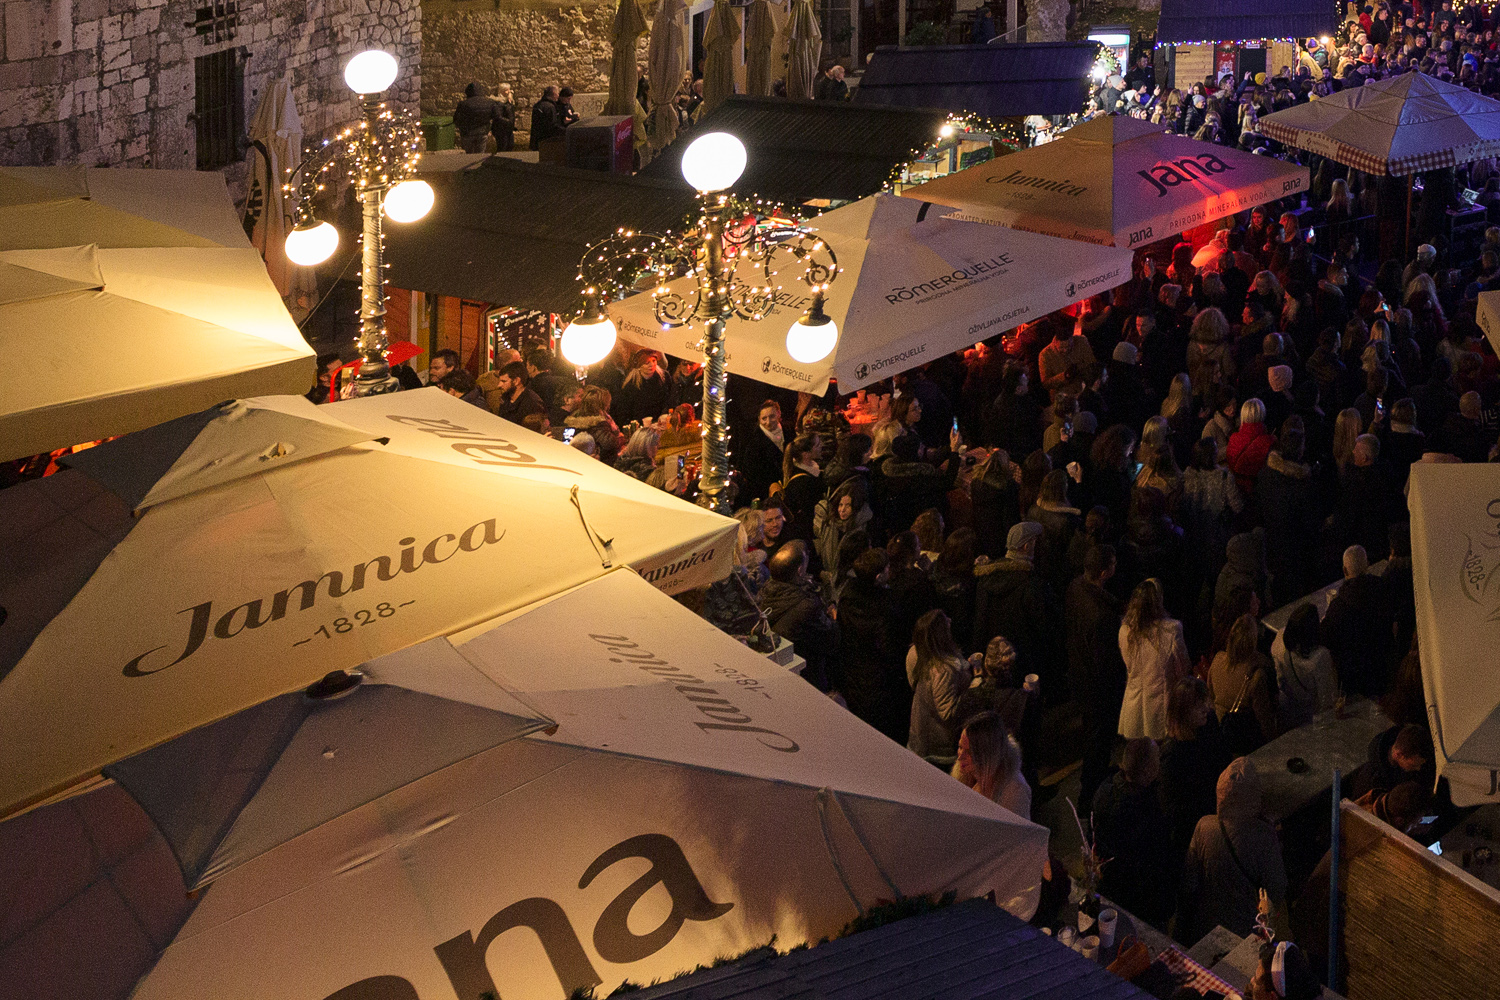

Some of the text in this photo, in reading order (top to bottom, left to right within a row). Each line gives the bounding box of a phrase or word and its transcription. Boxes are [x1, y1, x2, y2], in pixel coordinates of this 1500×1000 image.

[986, 169, 1088, 198] Jamnica
[1136, 153, 1236, 198] Jana
[1067, 230, 1104, 244] Jamnica
[1127, 177, 1301, 249] Jana PRIRODNA MINERALNA VODA Jana
[121, 517, 507, 678] Jamnica
[588, 632, 801, 754] Jamnica
